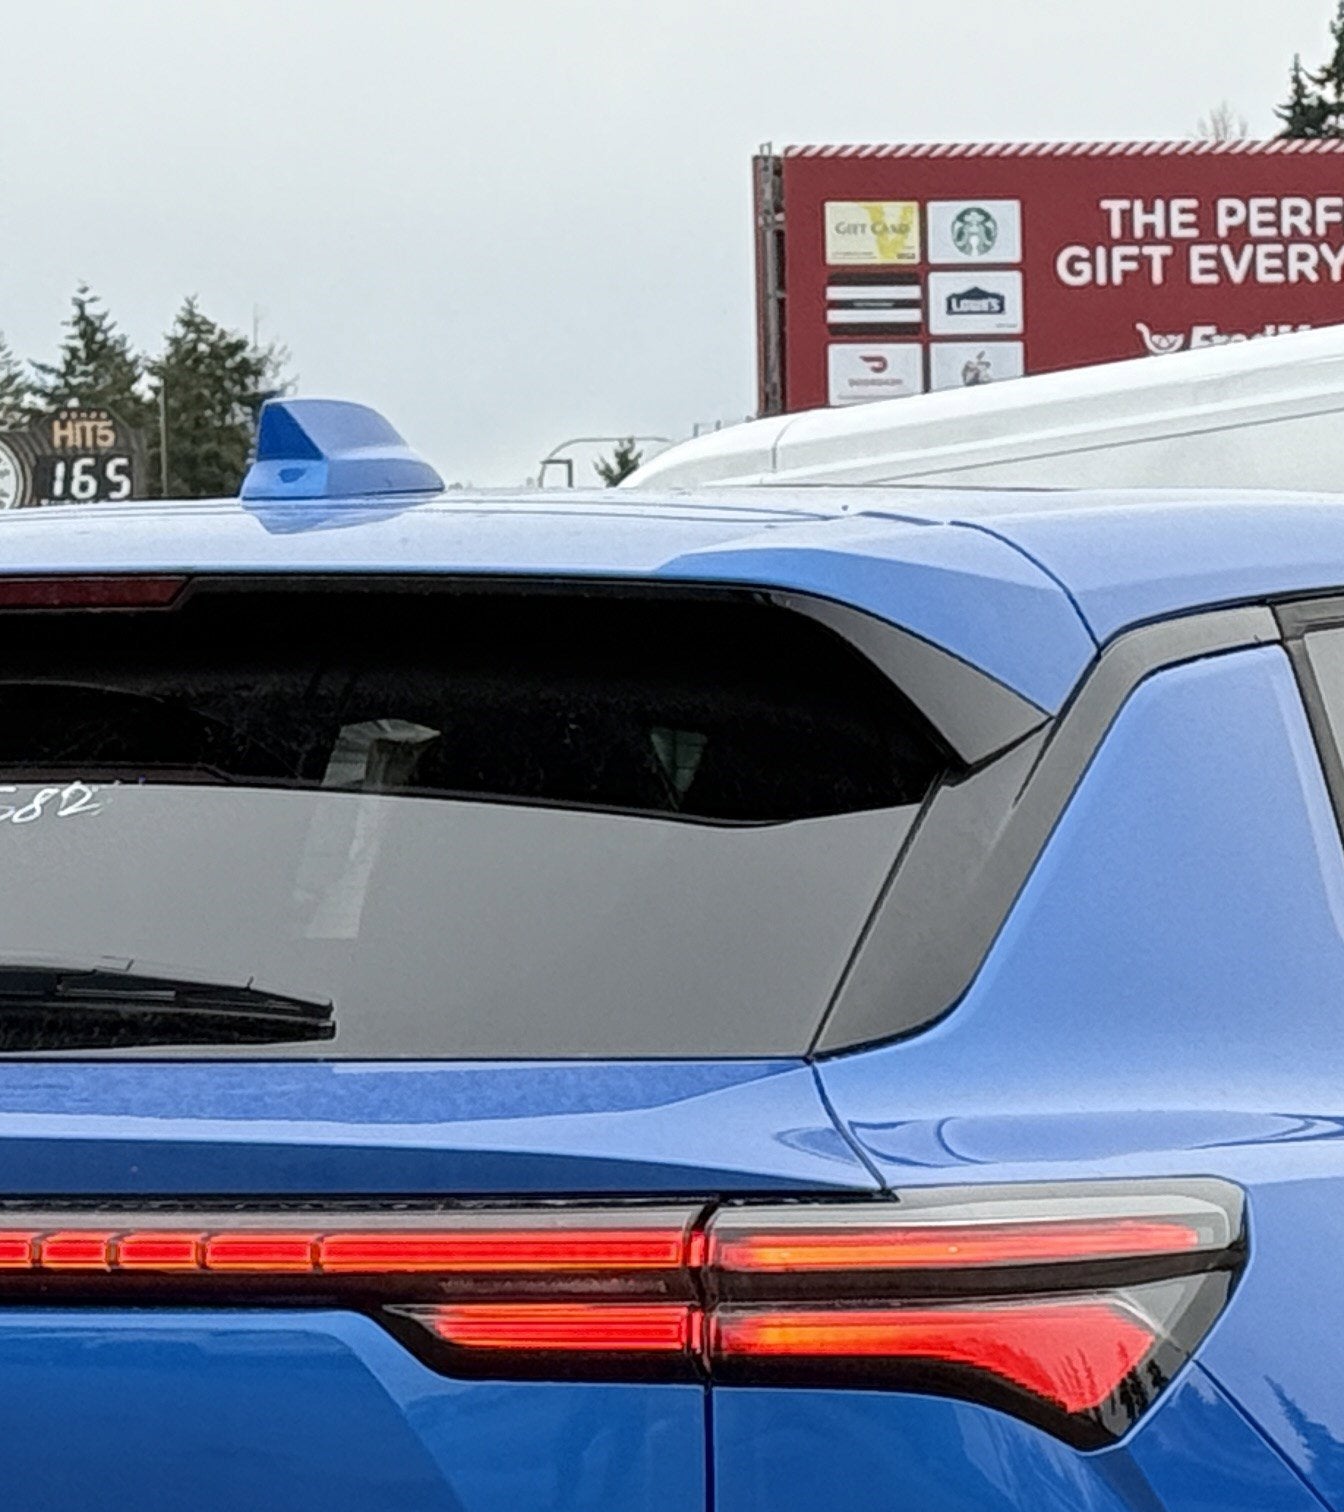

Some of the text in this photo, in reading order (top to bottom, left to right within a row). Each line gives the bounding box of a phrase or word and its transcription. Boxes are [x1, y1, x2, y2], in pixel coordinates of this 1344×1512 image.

[1099, 197, 1200, 240] THE
[1057, 244, 1174, 286] GIFT
[53, 457, 131, 500] 165
